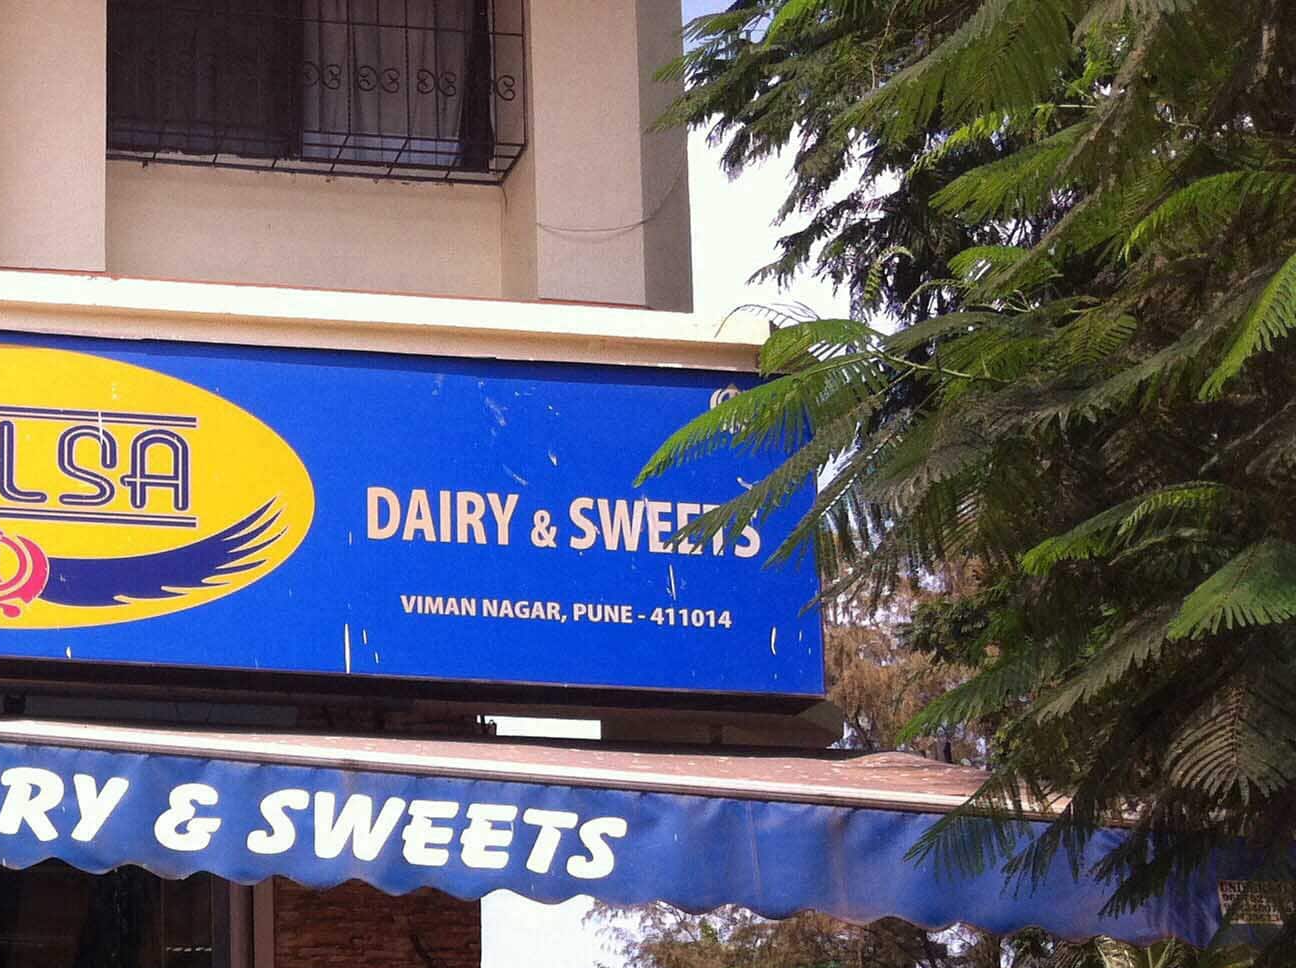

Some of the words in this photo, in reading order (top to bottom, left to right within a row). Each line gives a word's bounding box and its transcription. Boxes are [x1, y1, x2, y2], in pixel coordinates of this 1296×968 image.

[366, 486, 519, 546] DAIRY
[530, 509, 558, 548] &
[570, 496, 762, 559] SWEETS
[400, 594, 477, 617] VIMAN
[482, 598, 567, 624] NAGAR,
[573, 602, 633, 624] PUNE
[650, 606, 733, 629] 411014
[153, 782, 223, 852] &
[246, 788, 628, 880] SWEETS
